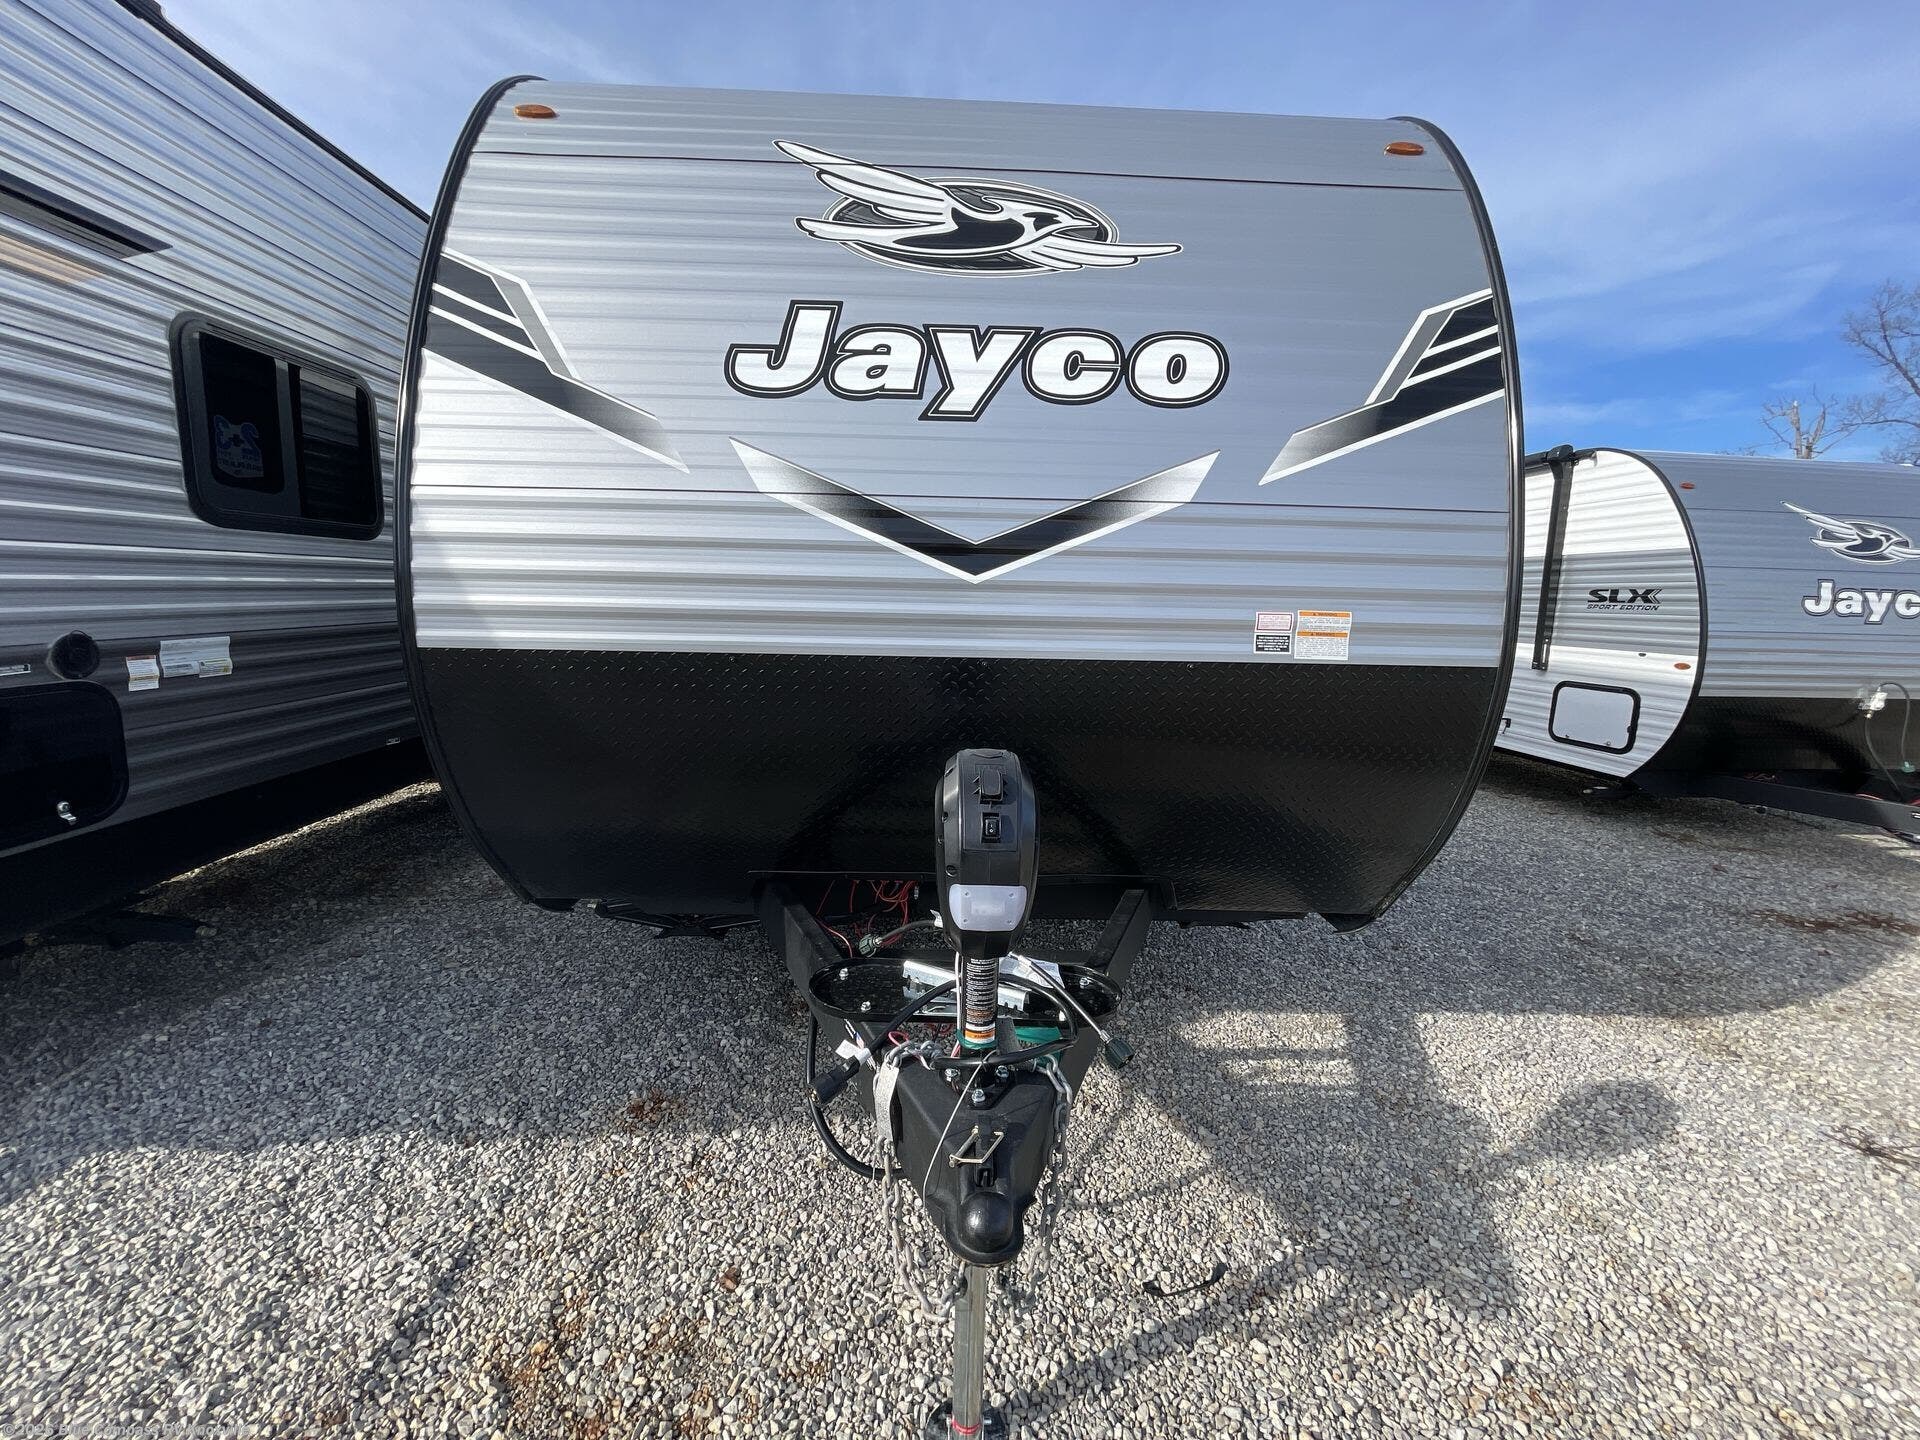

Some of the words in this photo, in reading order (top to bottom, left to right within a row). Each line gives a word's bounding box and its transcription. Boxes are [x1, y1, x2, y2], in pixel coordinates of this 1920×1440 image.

[724, 300, 1230, 421] Jayco
[1587, 588, 1662, 604] SLX
[1801, 579, 1920, 624] Jayc
